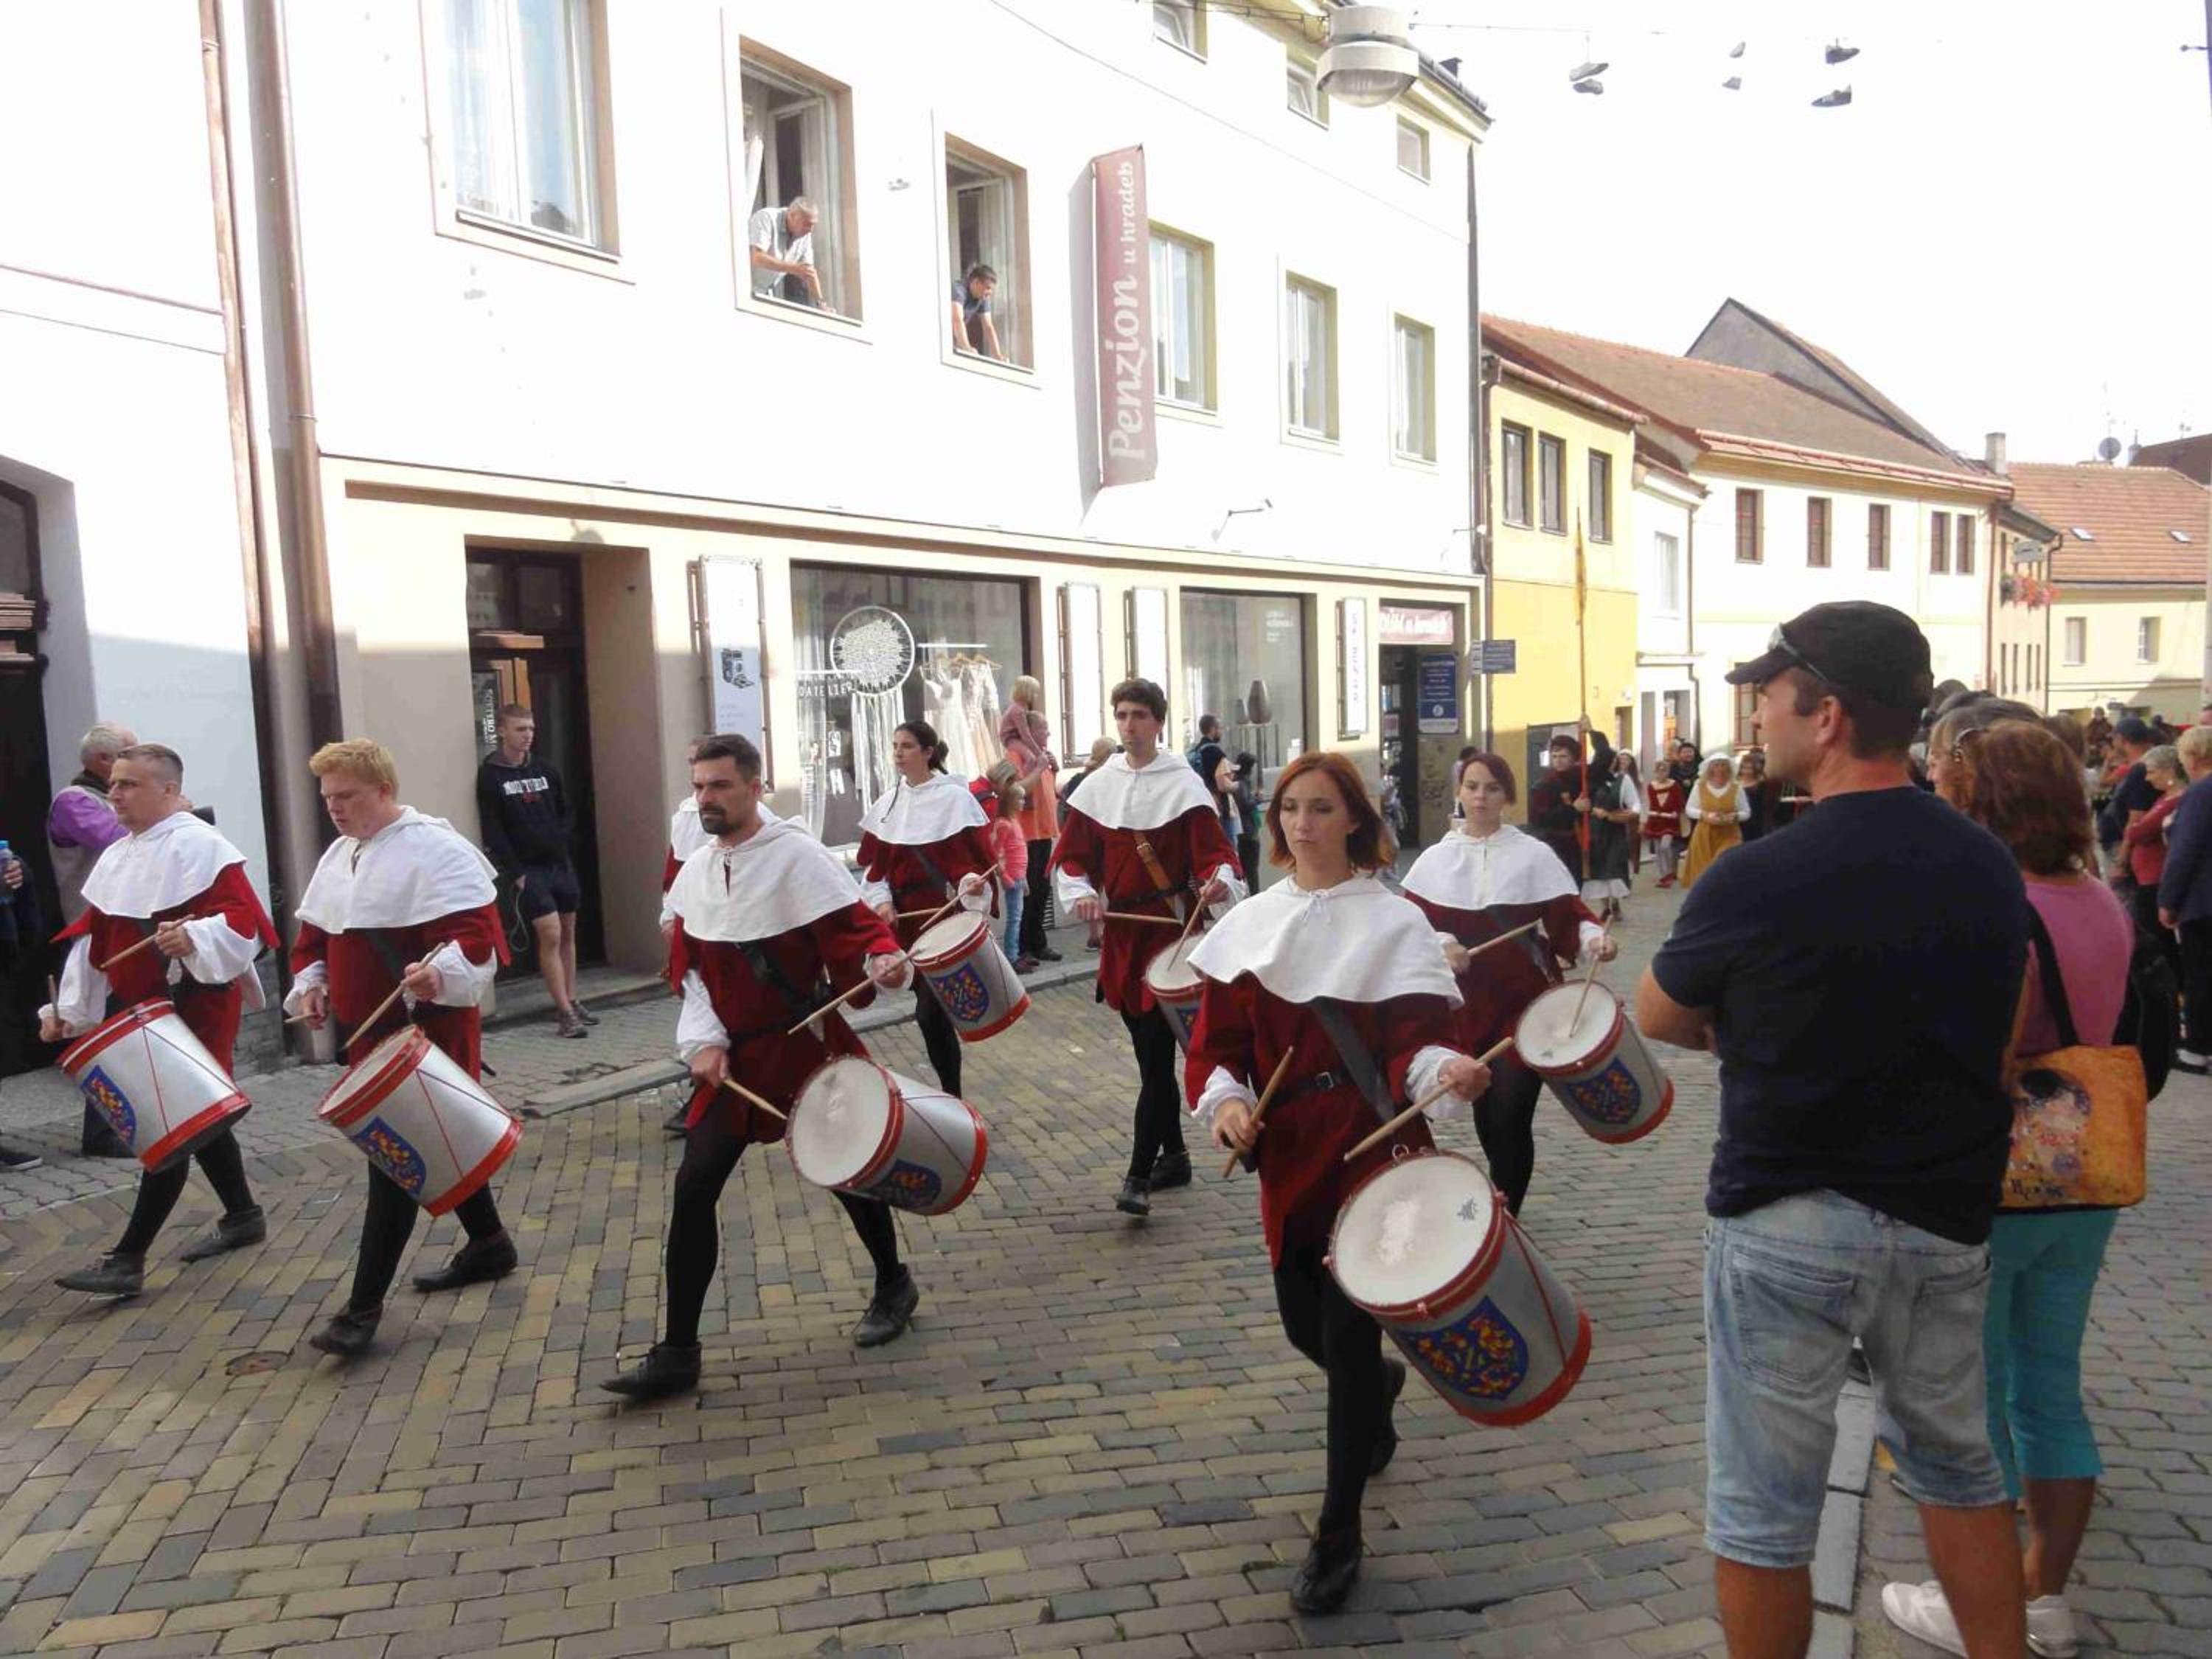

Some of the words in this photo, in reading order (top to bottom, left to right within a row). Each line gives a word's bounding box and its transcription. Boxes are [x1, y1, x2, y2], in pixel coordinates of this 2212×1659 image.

[1117, 161, 1135, 244] hradeb
[1124, 246, 1135, 264] u
[1105, 275, 1147, 461] Penzion
